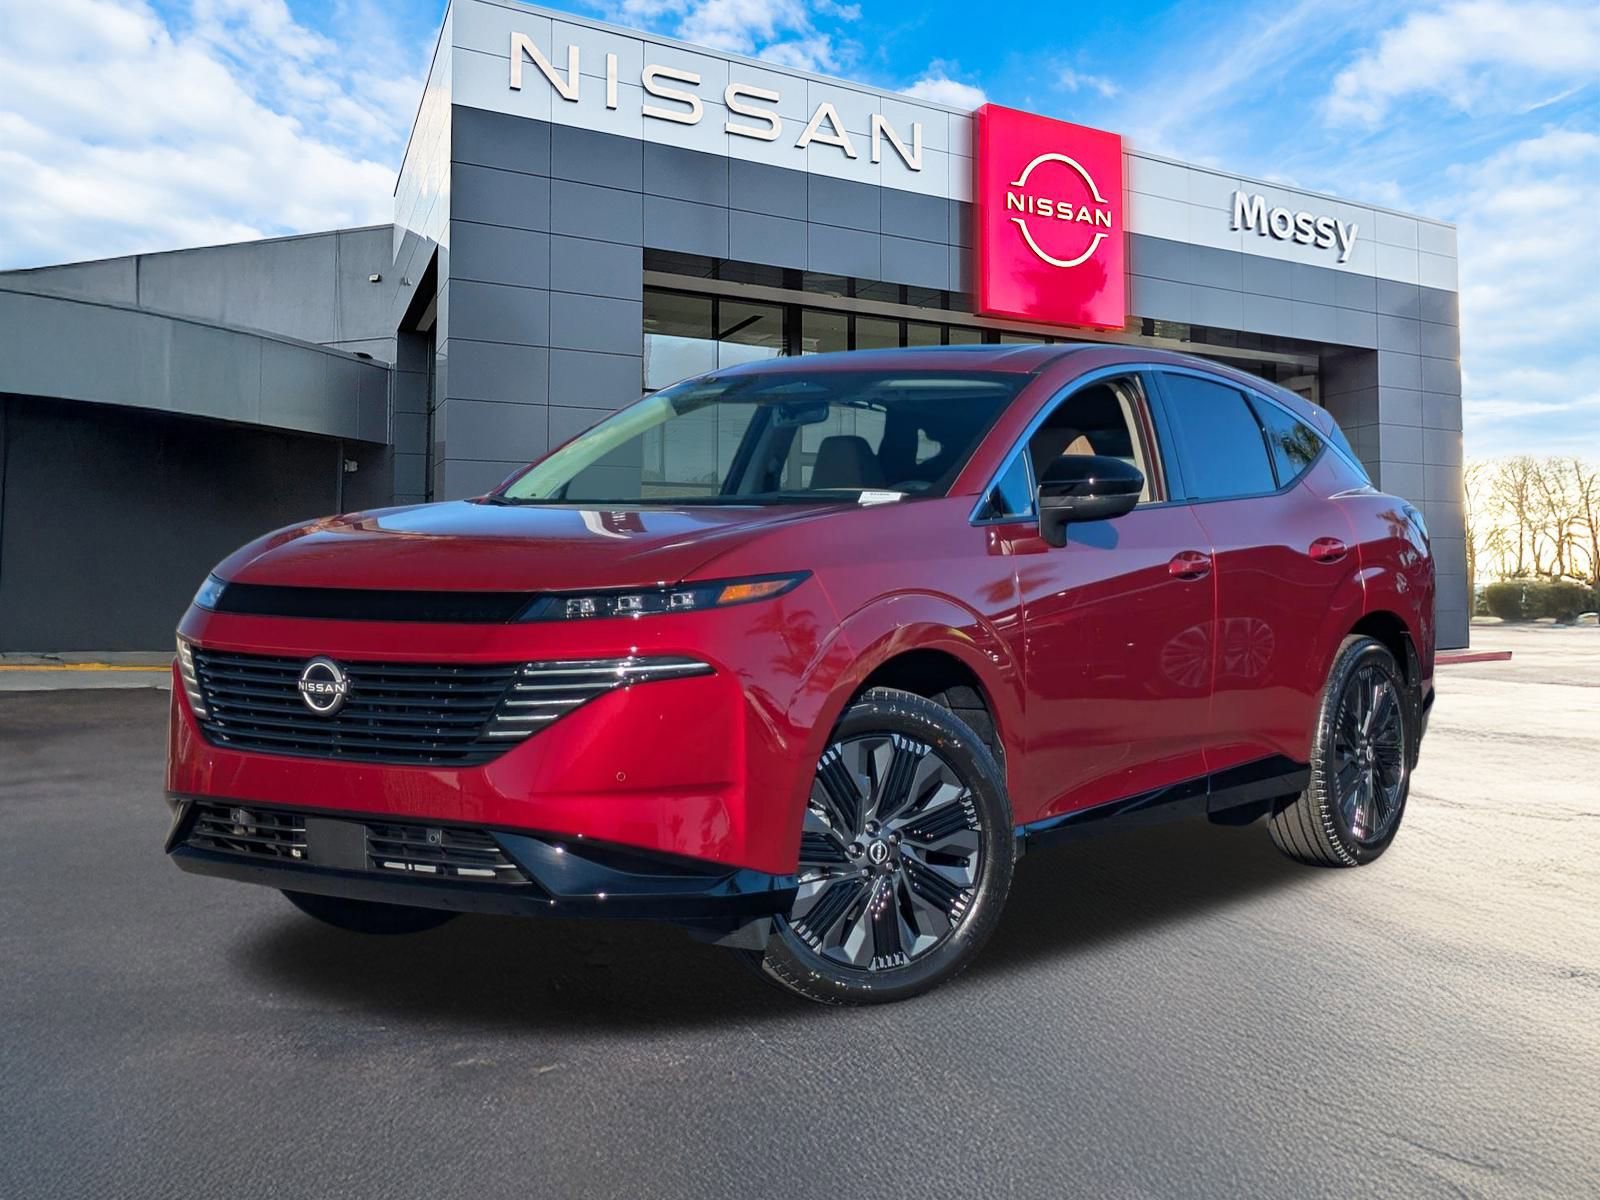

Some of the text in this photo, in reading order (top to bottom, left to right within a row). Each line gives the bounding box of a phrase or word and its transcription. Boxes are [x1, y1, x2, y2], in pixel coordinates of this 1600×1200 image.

[509, 31, 923, 172] NISSAN
[1006, 191, 1112, 228] NISSAN
[1231, 189, 1360, 263] Mossy
[298, 681, 345, 693] NISSAN
